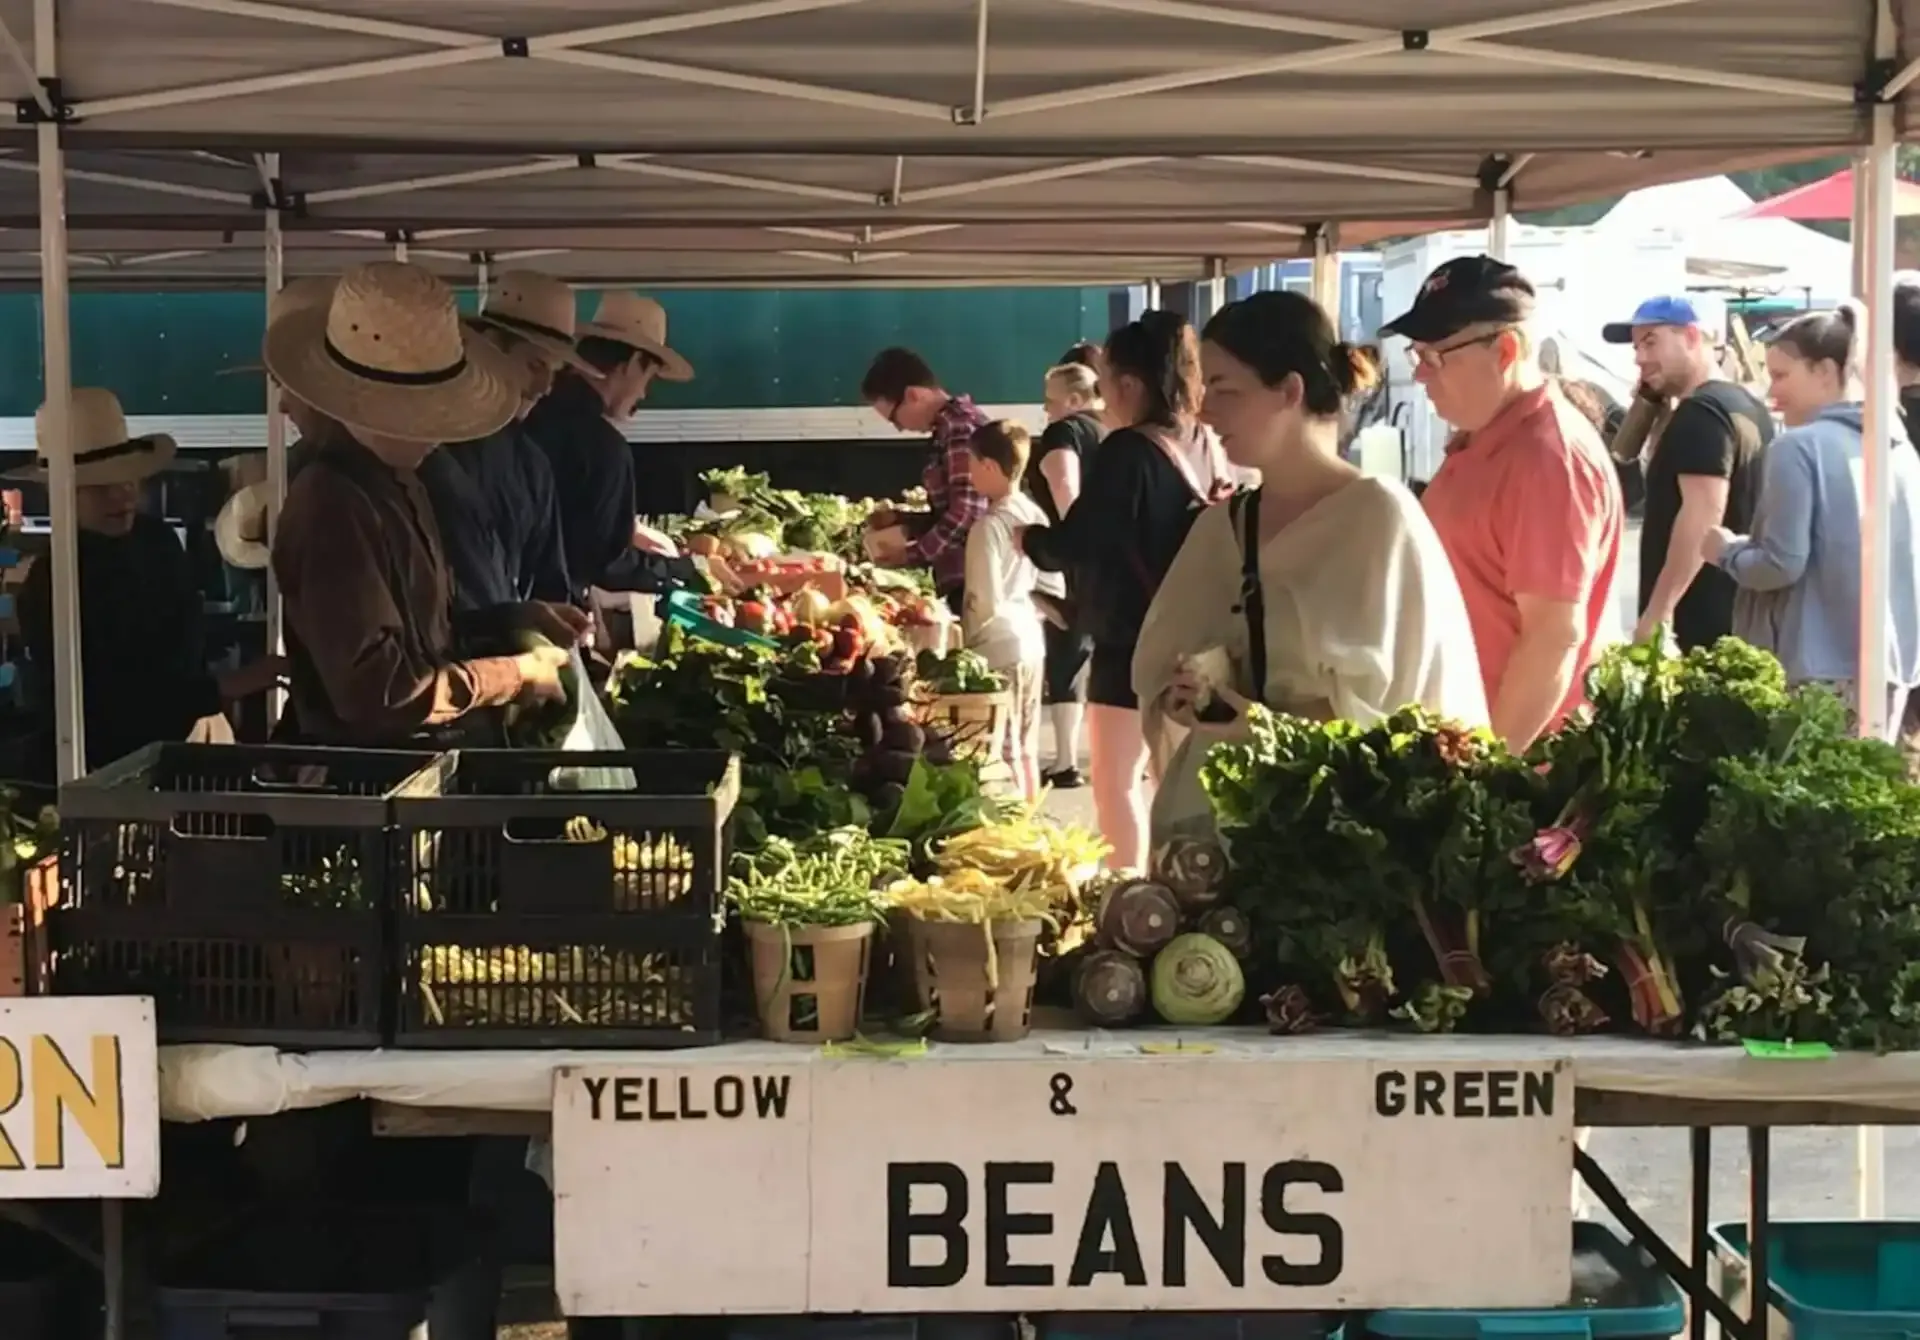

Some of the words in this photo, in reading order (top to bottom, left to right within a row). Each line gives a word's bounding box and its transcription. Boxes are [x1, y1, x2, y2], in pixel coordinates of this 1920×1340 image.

[581, 1075, 791, 1121] YELLOW
[1049, 1071, 1078, 1116] &
[1375, 1070, 1555, 1118] GREEN
[886, 1158, 1345, 1289] BEANS
